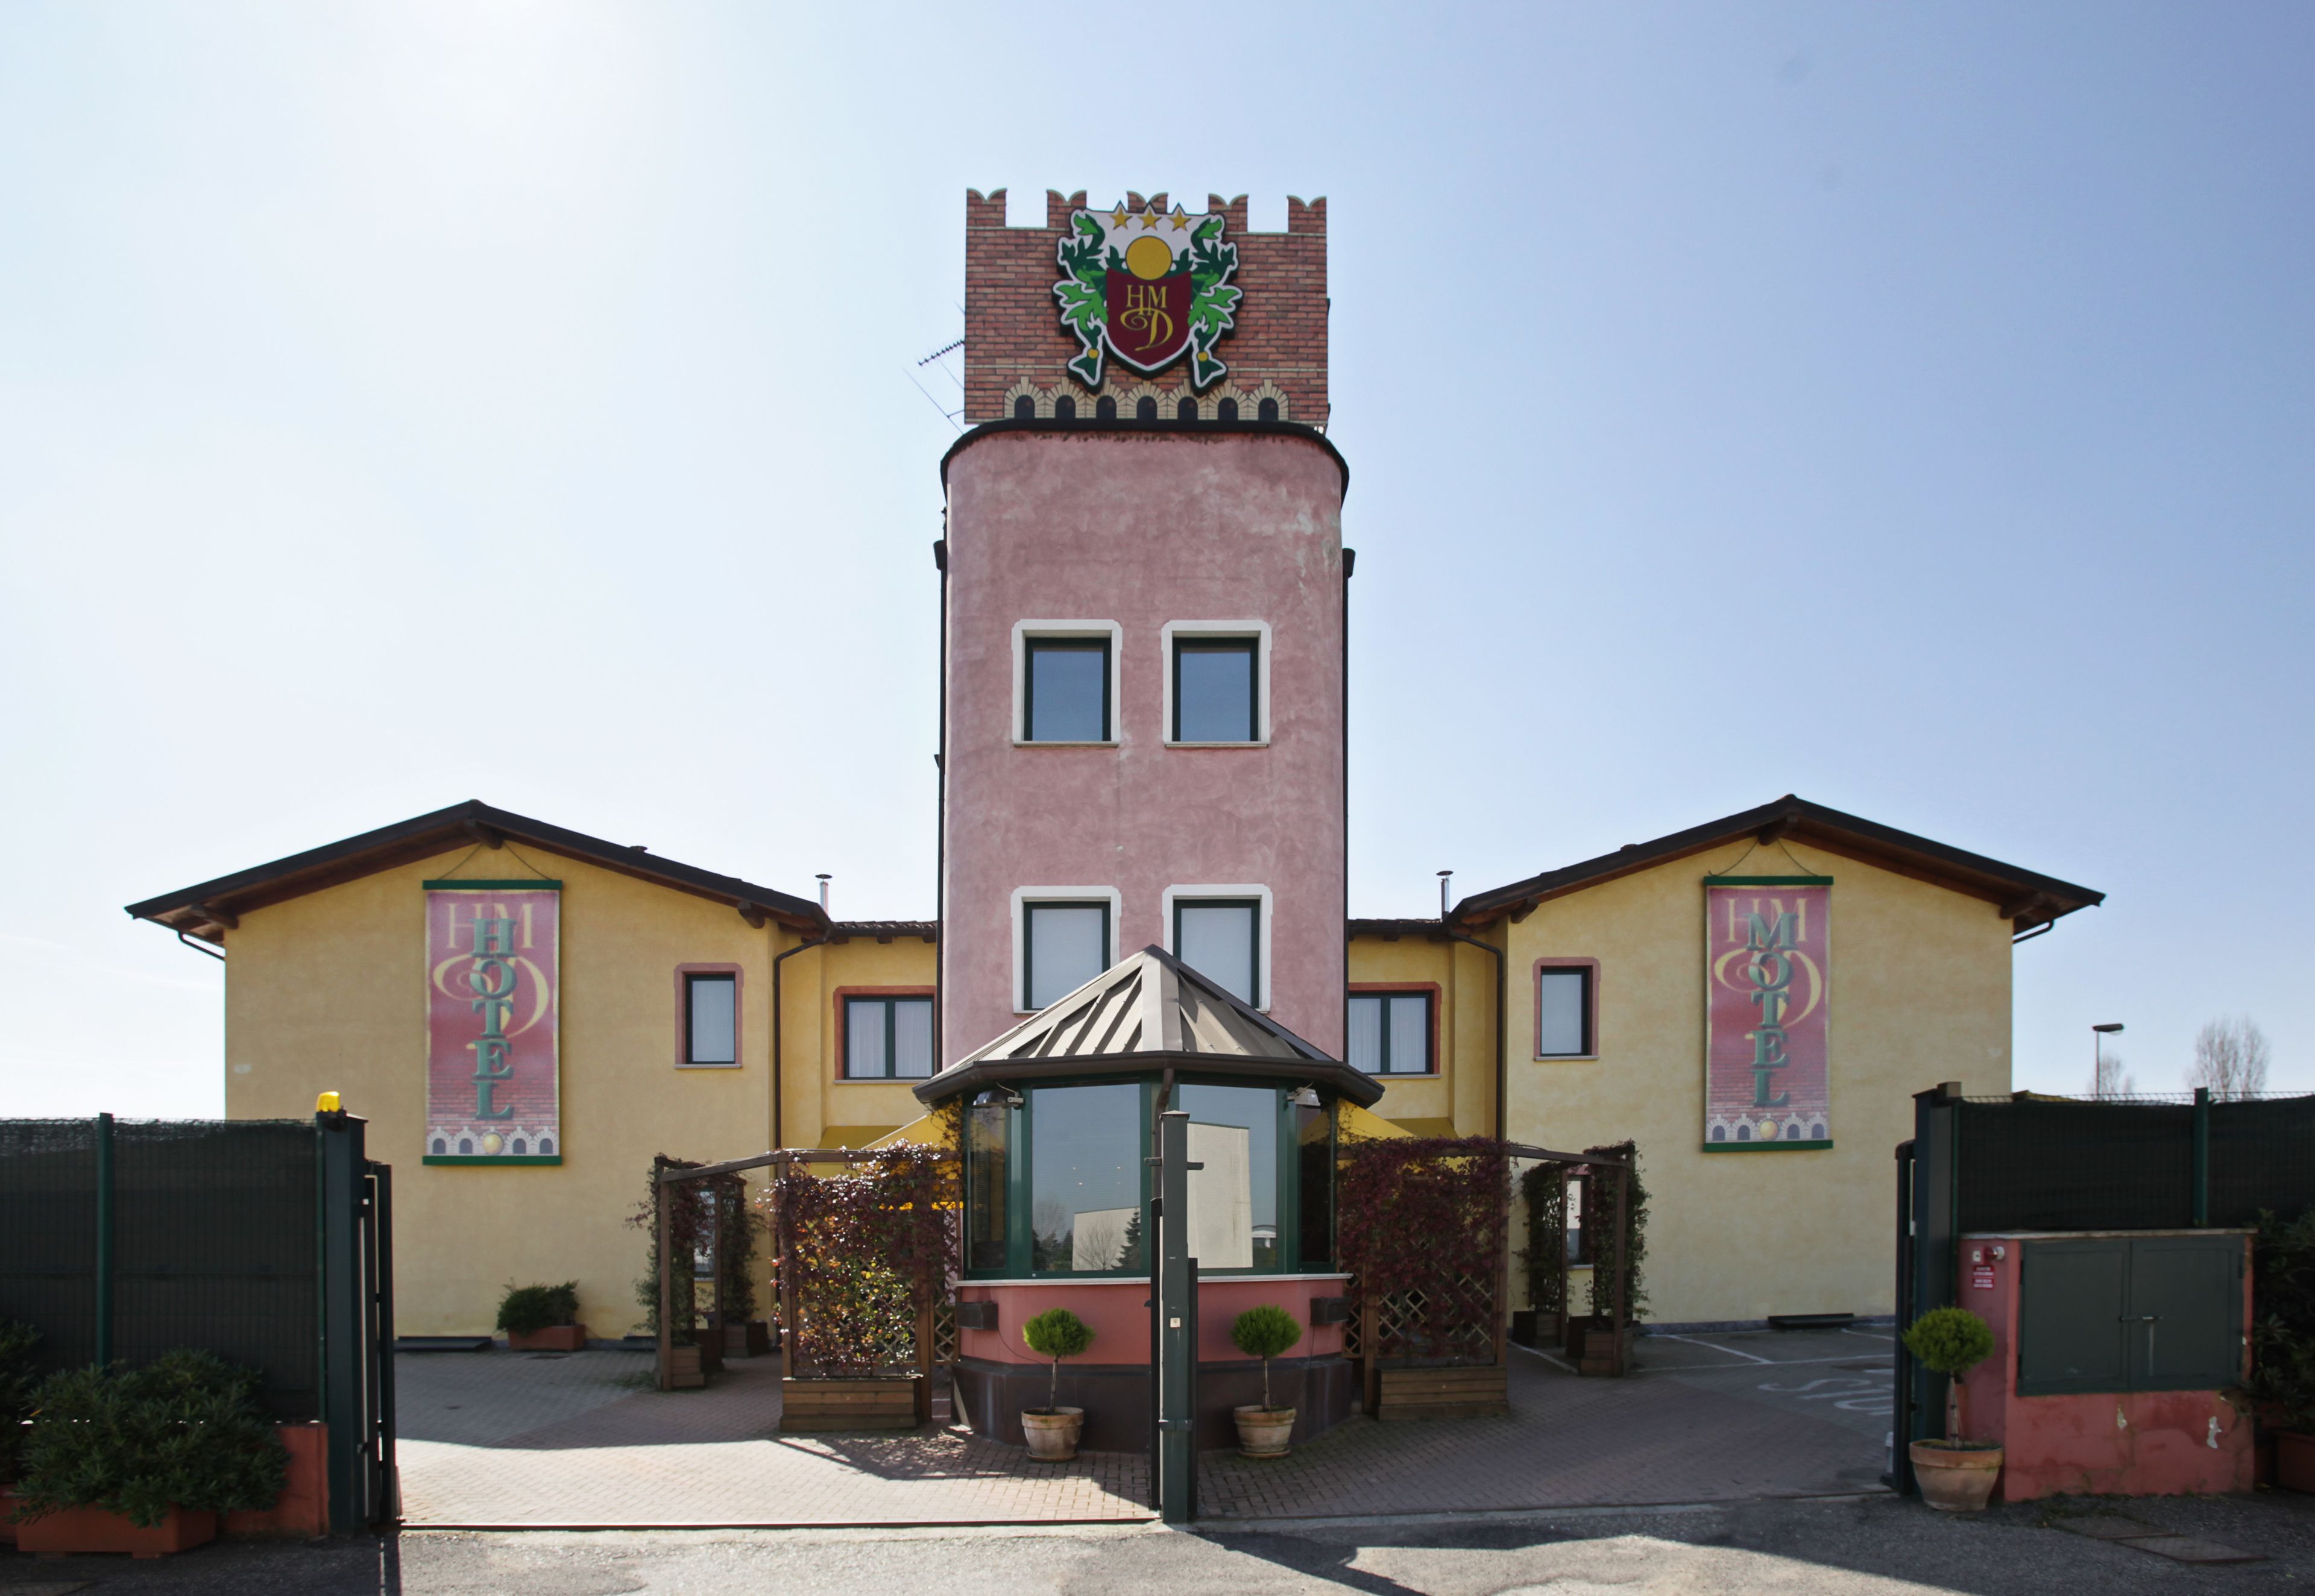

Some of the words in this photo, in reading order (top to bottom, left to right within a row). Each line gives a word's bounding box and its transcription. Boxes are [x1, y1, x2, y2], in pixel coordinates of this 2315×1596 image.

[1126, 284, 1167, 315] HM
[468, 917, 518, 1120] HOTEL
[1744, 913, 1799, 1107] MOTEL
